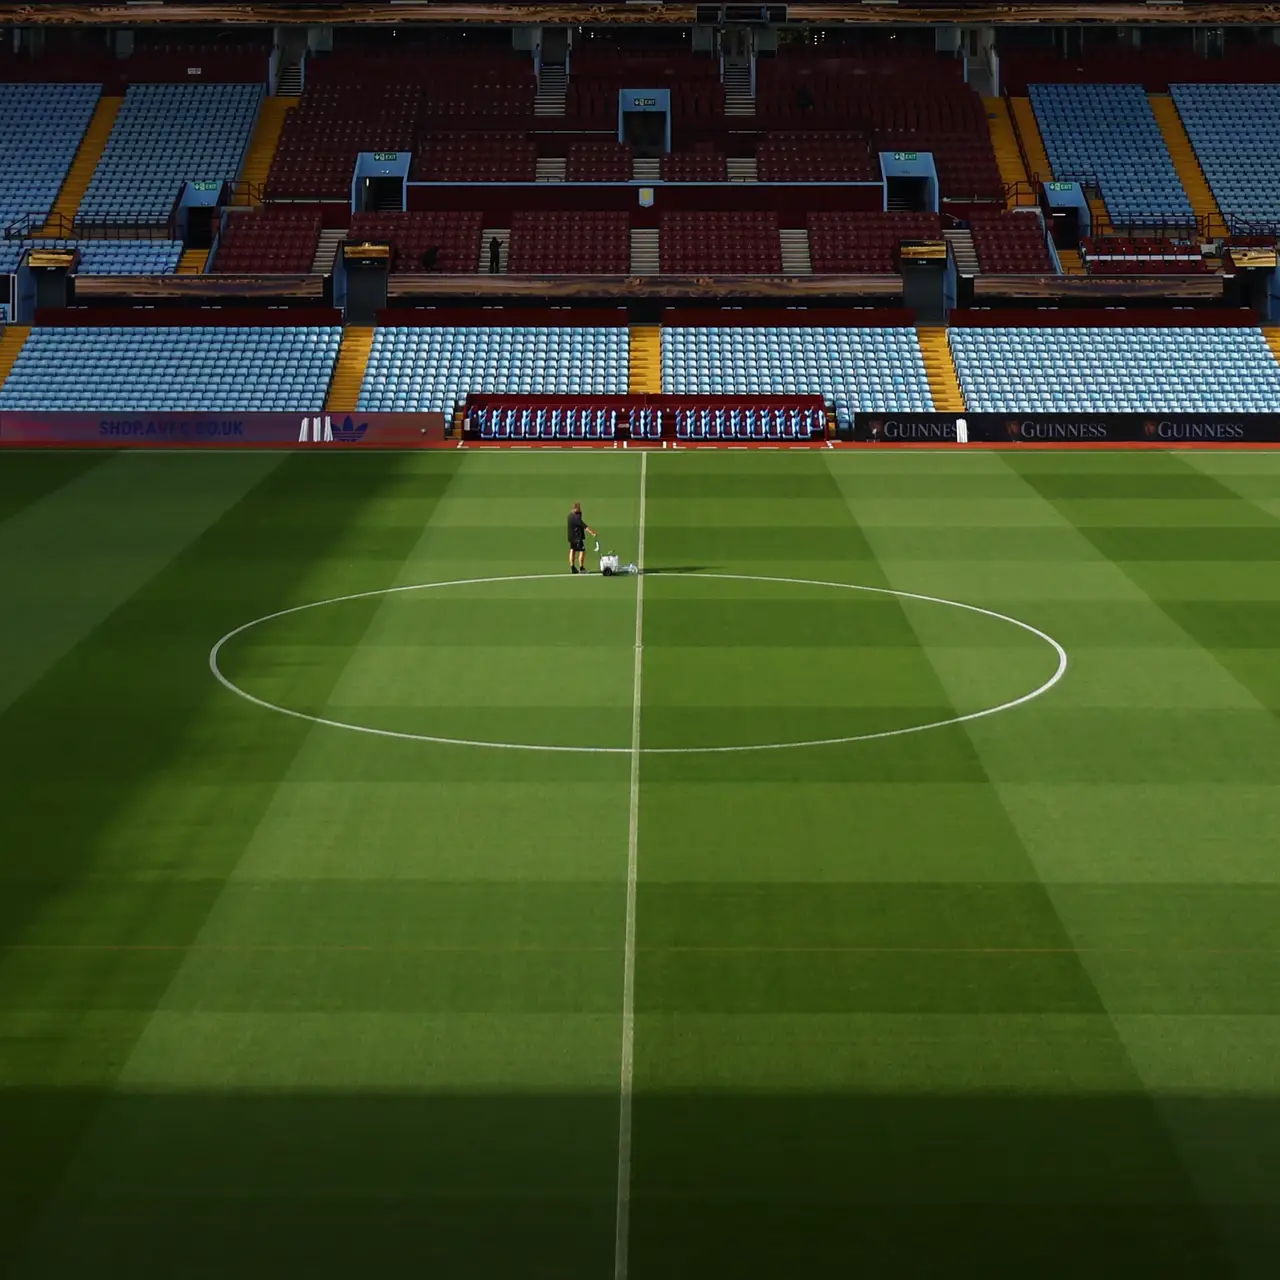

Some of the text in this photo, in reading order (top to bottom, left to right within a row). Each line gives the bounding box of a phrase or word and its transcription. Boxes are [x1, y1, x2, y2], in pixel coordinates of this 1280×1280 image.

[883, 421, 969, 437] GUINNES
[1021, 421, 1107, 437] GUINNESS
[1157, 421, 1244, 438] GUINNESS
